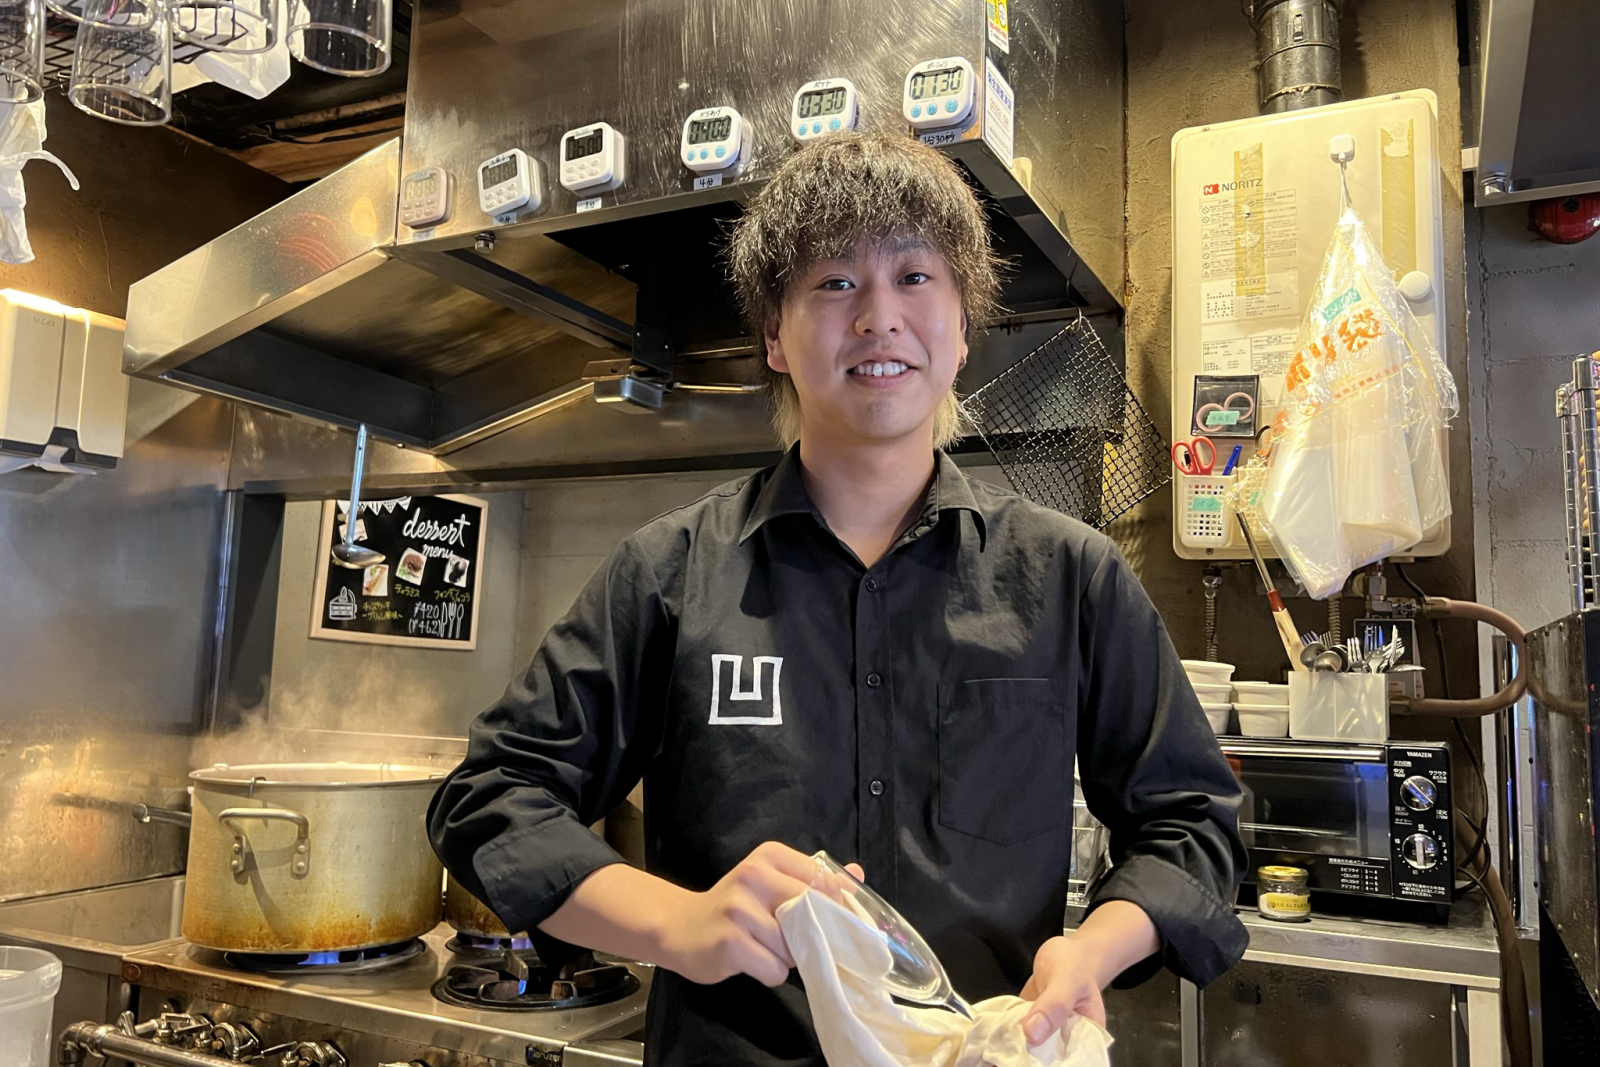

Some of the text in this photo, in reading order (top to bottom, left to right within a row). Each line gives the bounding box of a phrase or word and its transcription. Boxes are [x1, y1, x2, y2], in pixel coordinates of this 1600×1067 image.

[911, 69, 963, 101] 0130
[699, 178, 713, 188] 4分
[1221, 178, 1263, 192] NORITZ
[402, 507, 471, 547] dessert
[421, 544, 453, 559] menu
[394, 583, 421, 598] ティラミス
